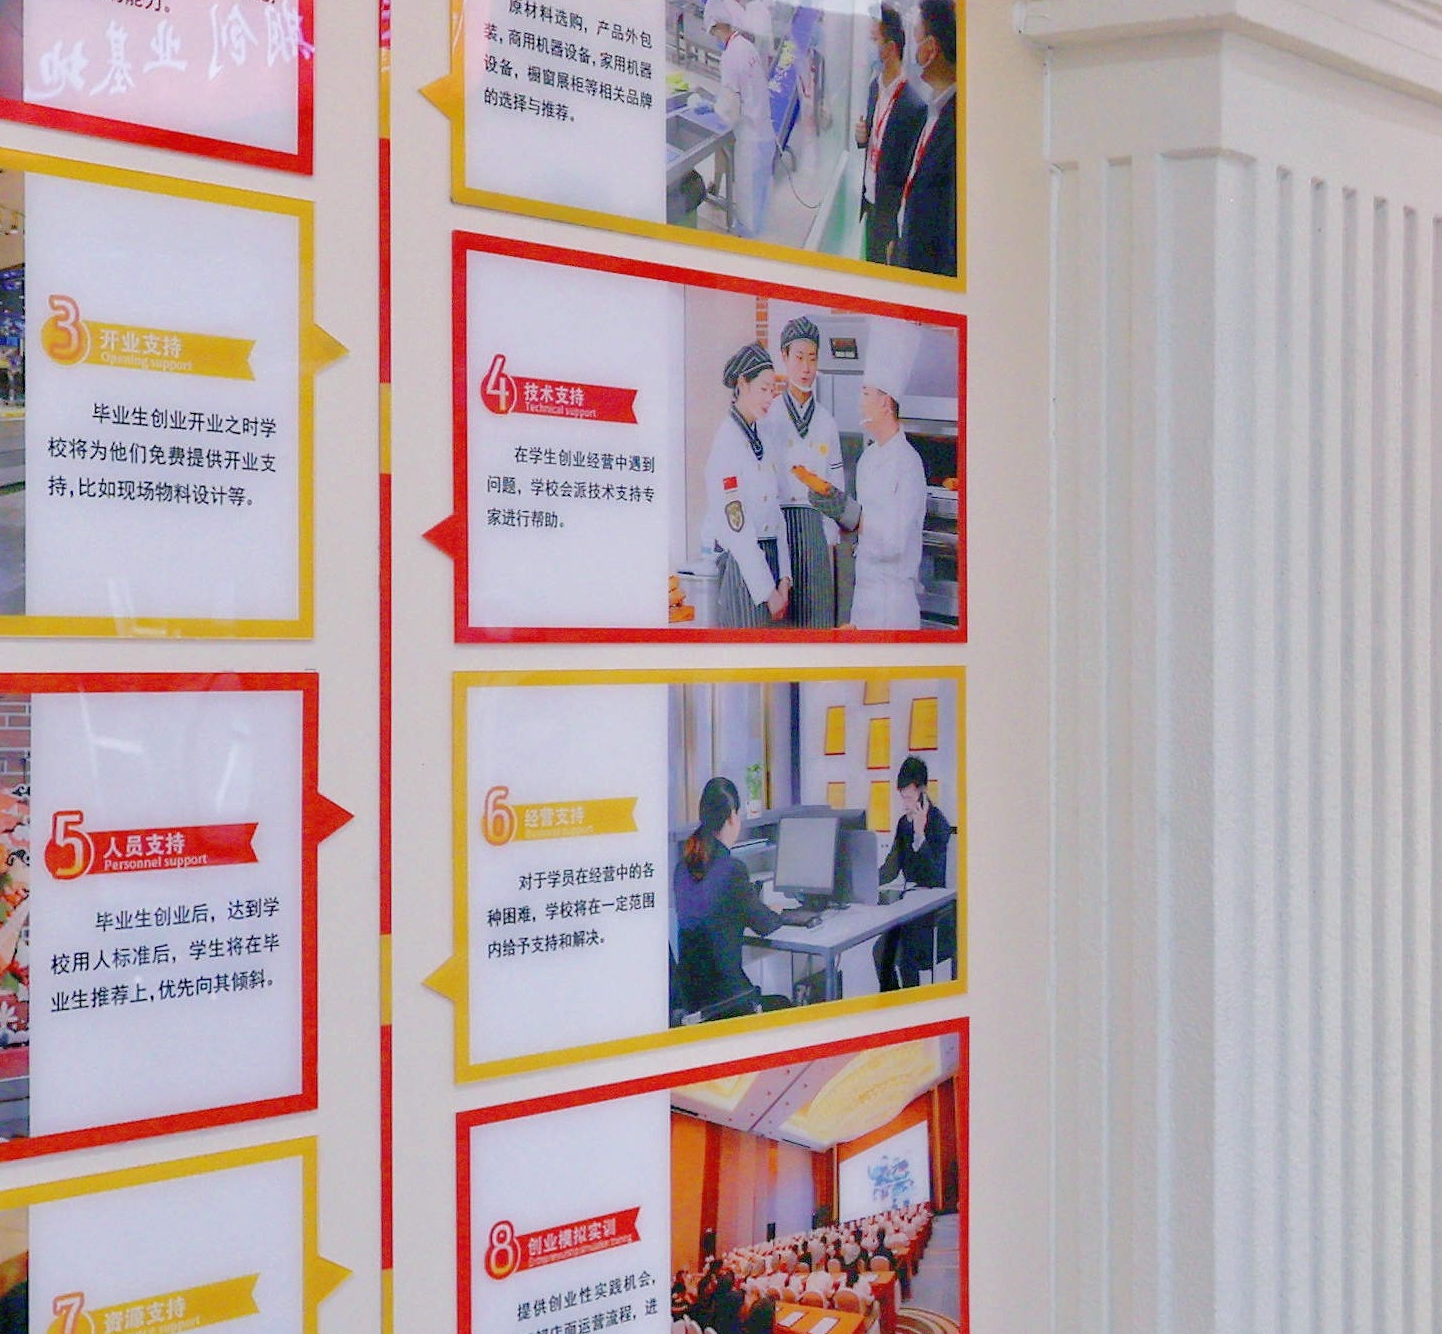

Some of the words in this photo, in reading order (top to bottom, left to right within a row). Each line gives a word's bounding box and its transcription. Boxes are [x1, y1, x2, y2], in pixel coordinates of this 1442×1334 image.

[484, 22, 652, 80] 装，商用机器设备，家用机器
[484, 54, 653, 110] 设备，橱窗展柜等相关品牌
[484, 86, 576, 123] 的选择与推荐。
[49, 294, 80, 361] 3
[99, 328, 182, 358] 开业支持
[485, 354, 510, 412] 4
[524, 382, 584, 406] 技术支持
[93, 403, 276, 438] 毕业生创业开业之时学
[48, 437, 276, 473] 校将为他们免费提供开业支
[514, 445, 655, 474] 在学生创业经营中遇到
[48, 475, 253, 507] 持，比如现场物料设计等。
[487, 475, 655, 503] 问题，学校会派技术支持专
[487, 508, 565, 529] 家进行帮助。
[484, 785, 515, 846] 6
[525, 807, 585, 828] 经营支持
[52, 810, 84, 878] 5
[103, 832, 185, 859] 人员支持
[104, 857, 162, 872] Personnel
[164, 853, 208, 869] support
[519, 862, 655, 891] 对于学员在经营中的各
[95, 897, 280, 932] 毕业生创业后，达到学
[487, 892, 655, 927] 种困难，学校将在一定范围
[51, 932, 280, 975] 校用人标准后，学生将在毕
[488, 929, 605, 959] 内给予支持和解决。
[51, 969, 275, 1013] 业生推荐上，优先向其倾斜。
[488, 1220, 515, 1280] 8
[528, 1218, 617, 1257] 创业模拟实训
[518, 1270, 656, 1322] 提供创业性实践机会，
[104, 1296, 186, 1334] 资源支持
